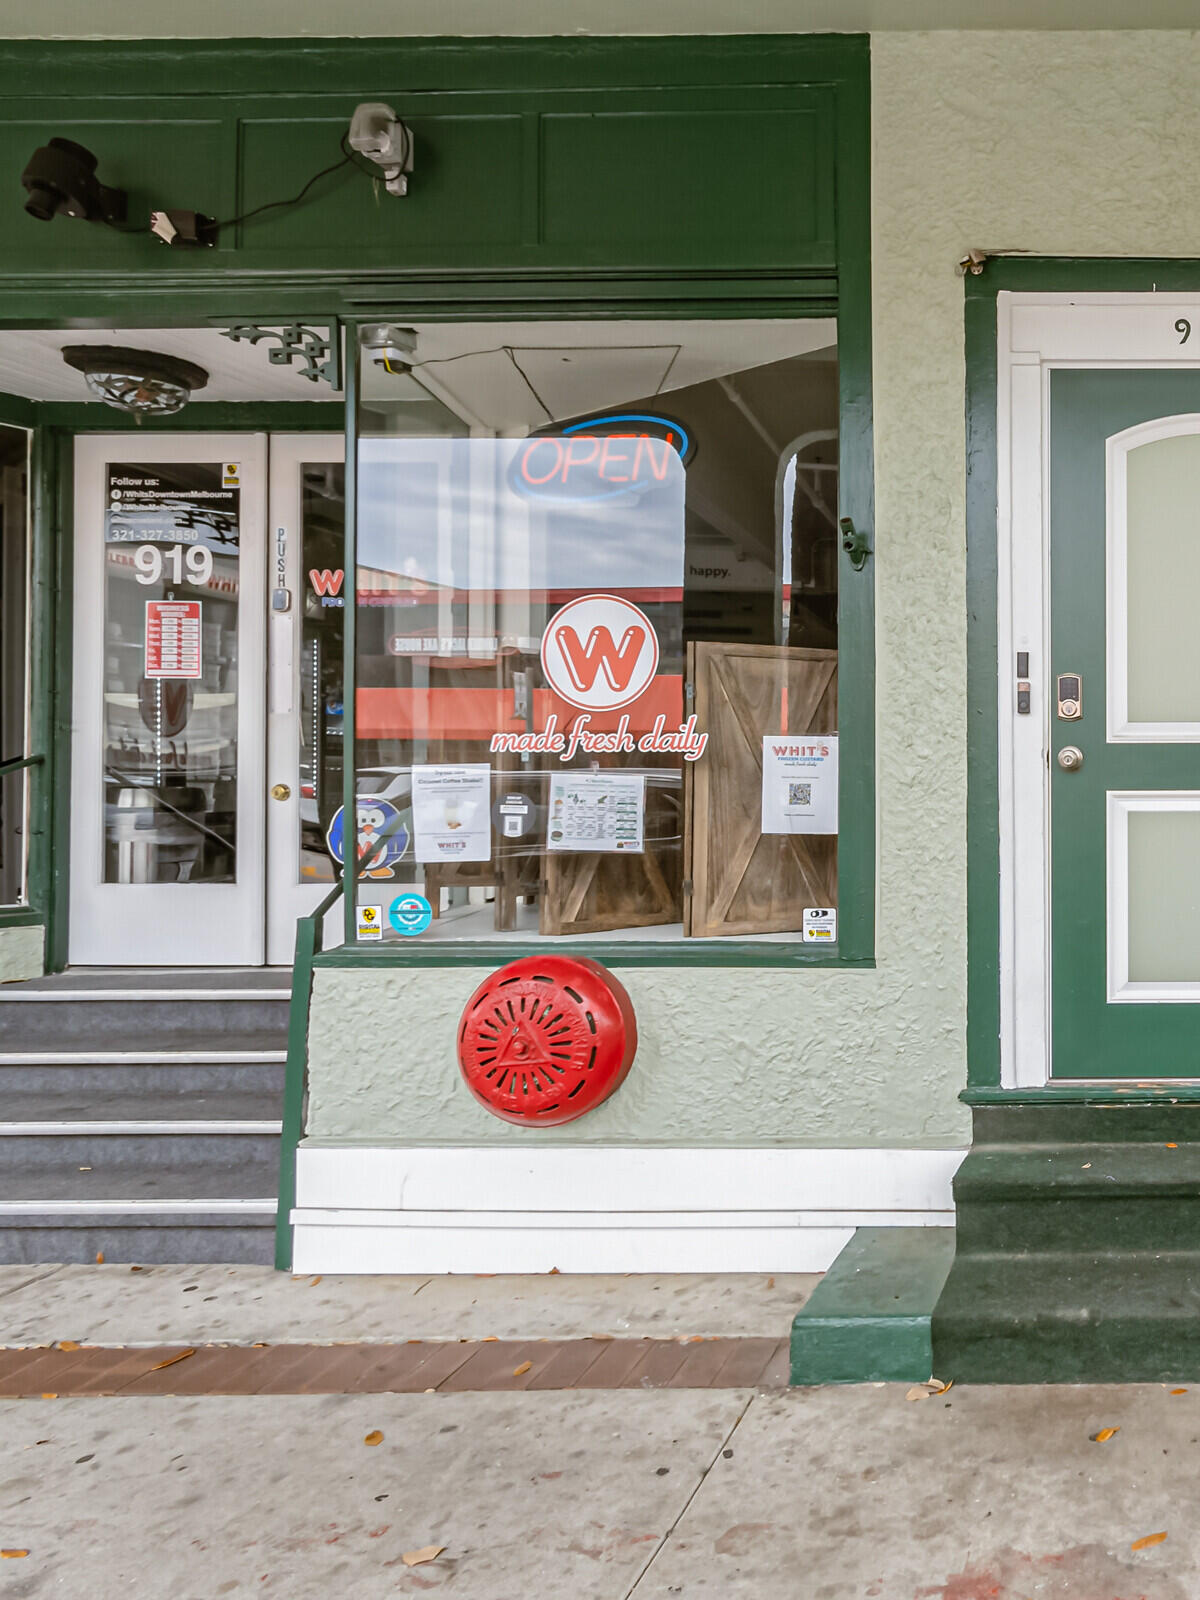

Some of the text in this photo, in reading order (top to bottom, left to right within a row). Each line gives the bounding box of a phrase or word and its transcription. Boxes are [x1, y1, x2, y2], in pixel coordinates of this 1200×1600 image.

[521, 432, 673, 484] OPEN
[110, 477, 160, 486] Follow us:
[111, 529, 199, 541] 321-327-3850
[134, 544, 213, 585] 919
[277, 528, 286, 587] PUSH
[689, 564, 731, 579] happy.
[555, 625, 646, 692] W
[490, 714, 709, 761] made fresh daily
[772, 744, 829, 757] WHIT'S
